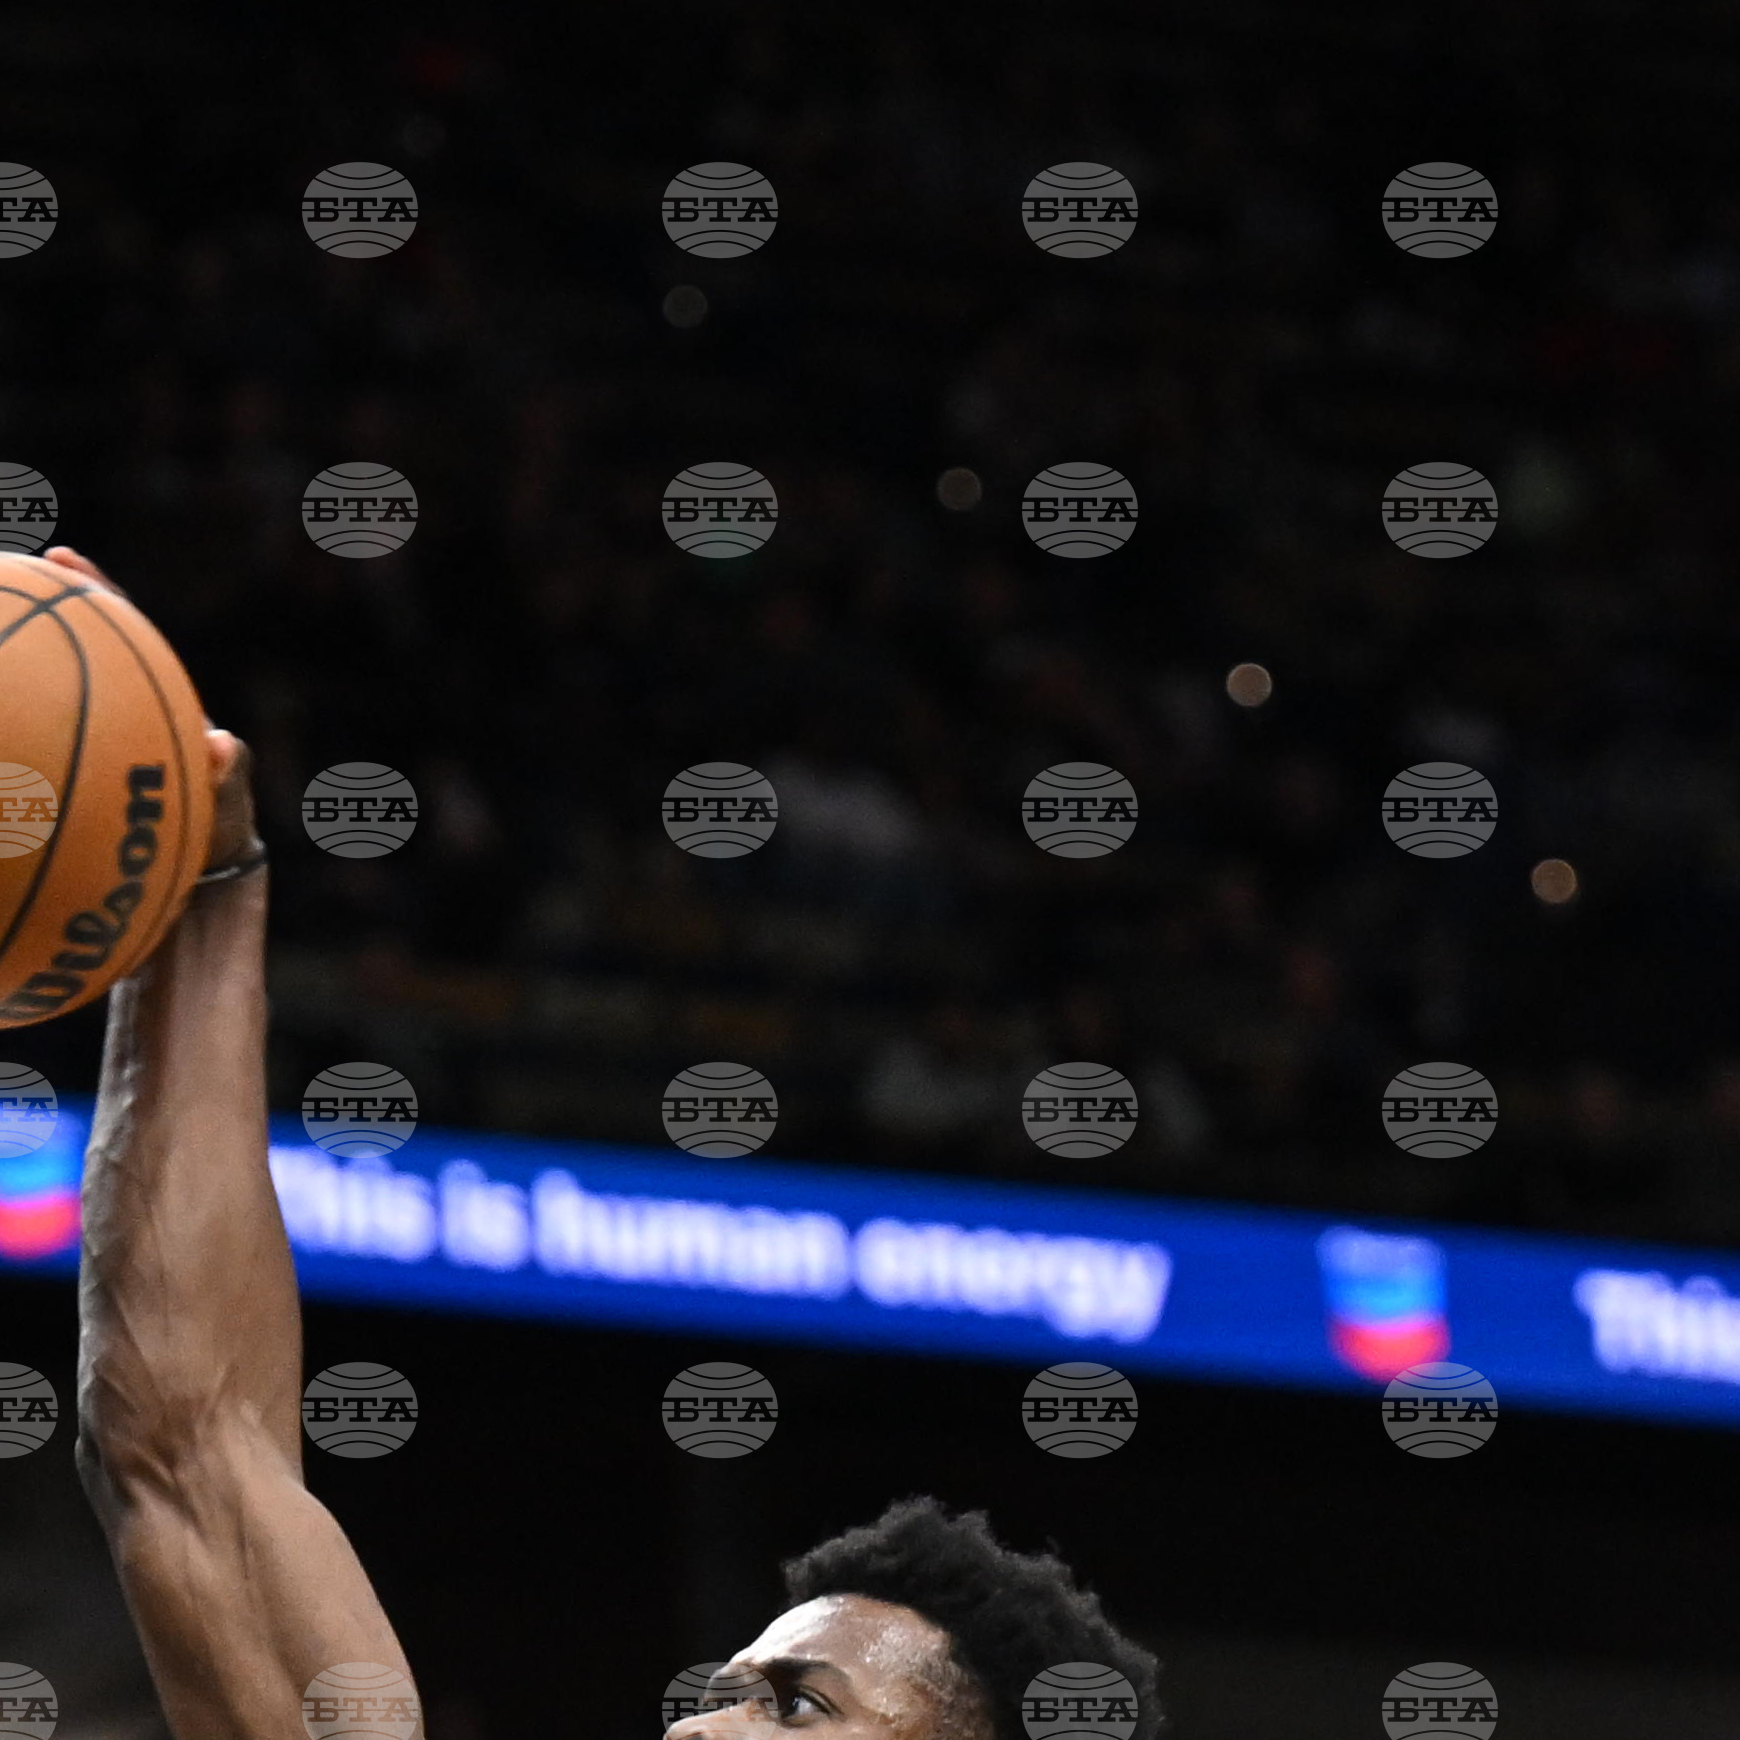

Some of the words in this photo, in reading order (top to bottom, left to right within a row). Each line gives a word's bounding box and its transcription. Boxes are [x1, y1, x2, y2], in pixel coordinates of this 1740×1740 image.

[438, 1158, 530, 1272] is
[531, 1168, 852, 1300] human
[855, 1216, 1173, 1344] energy
